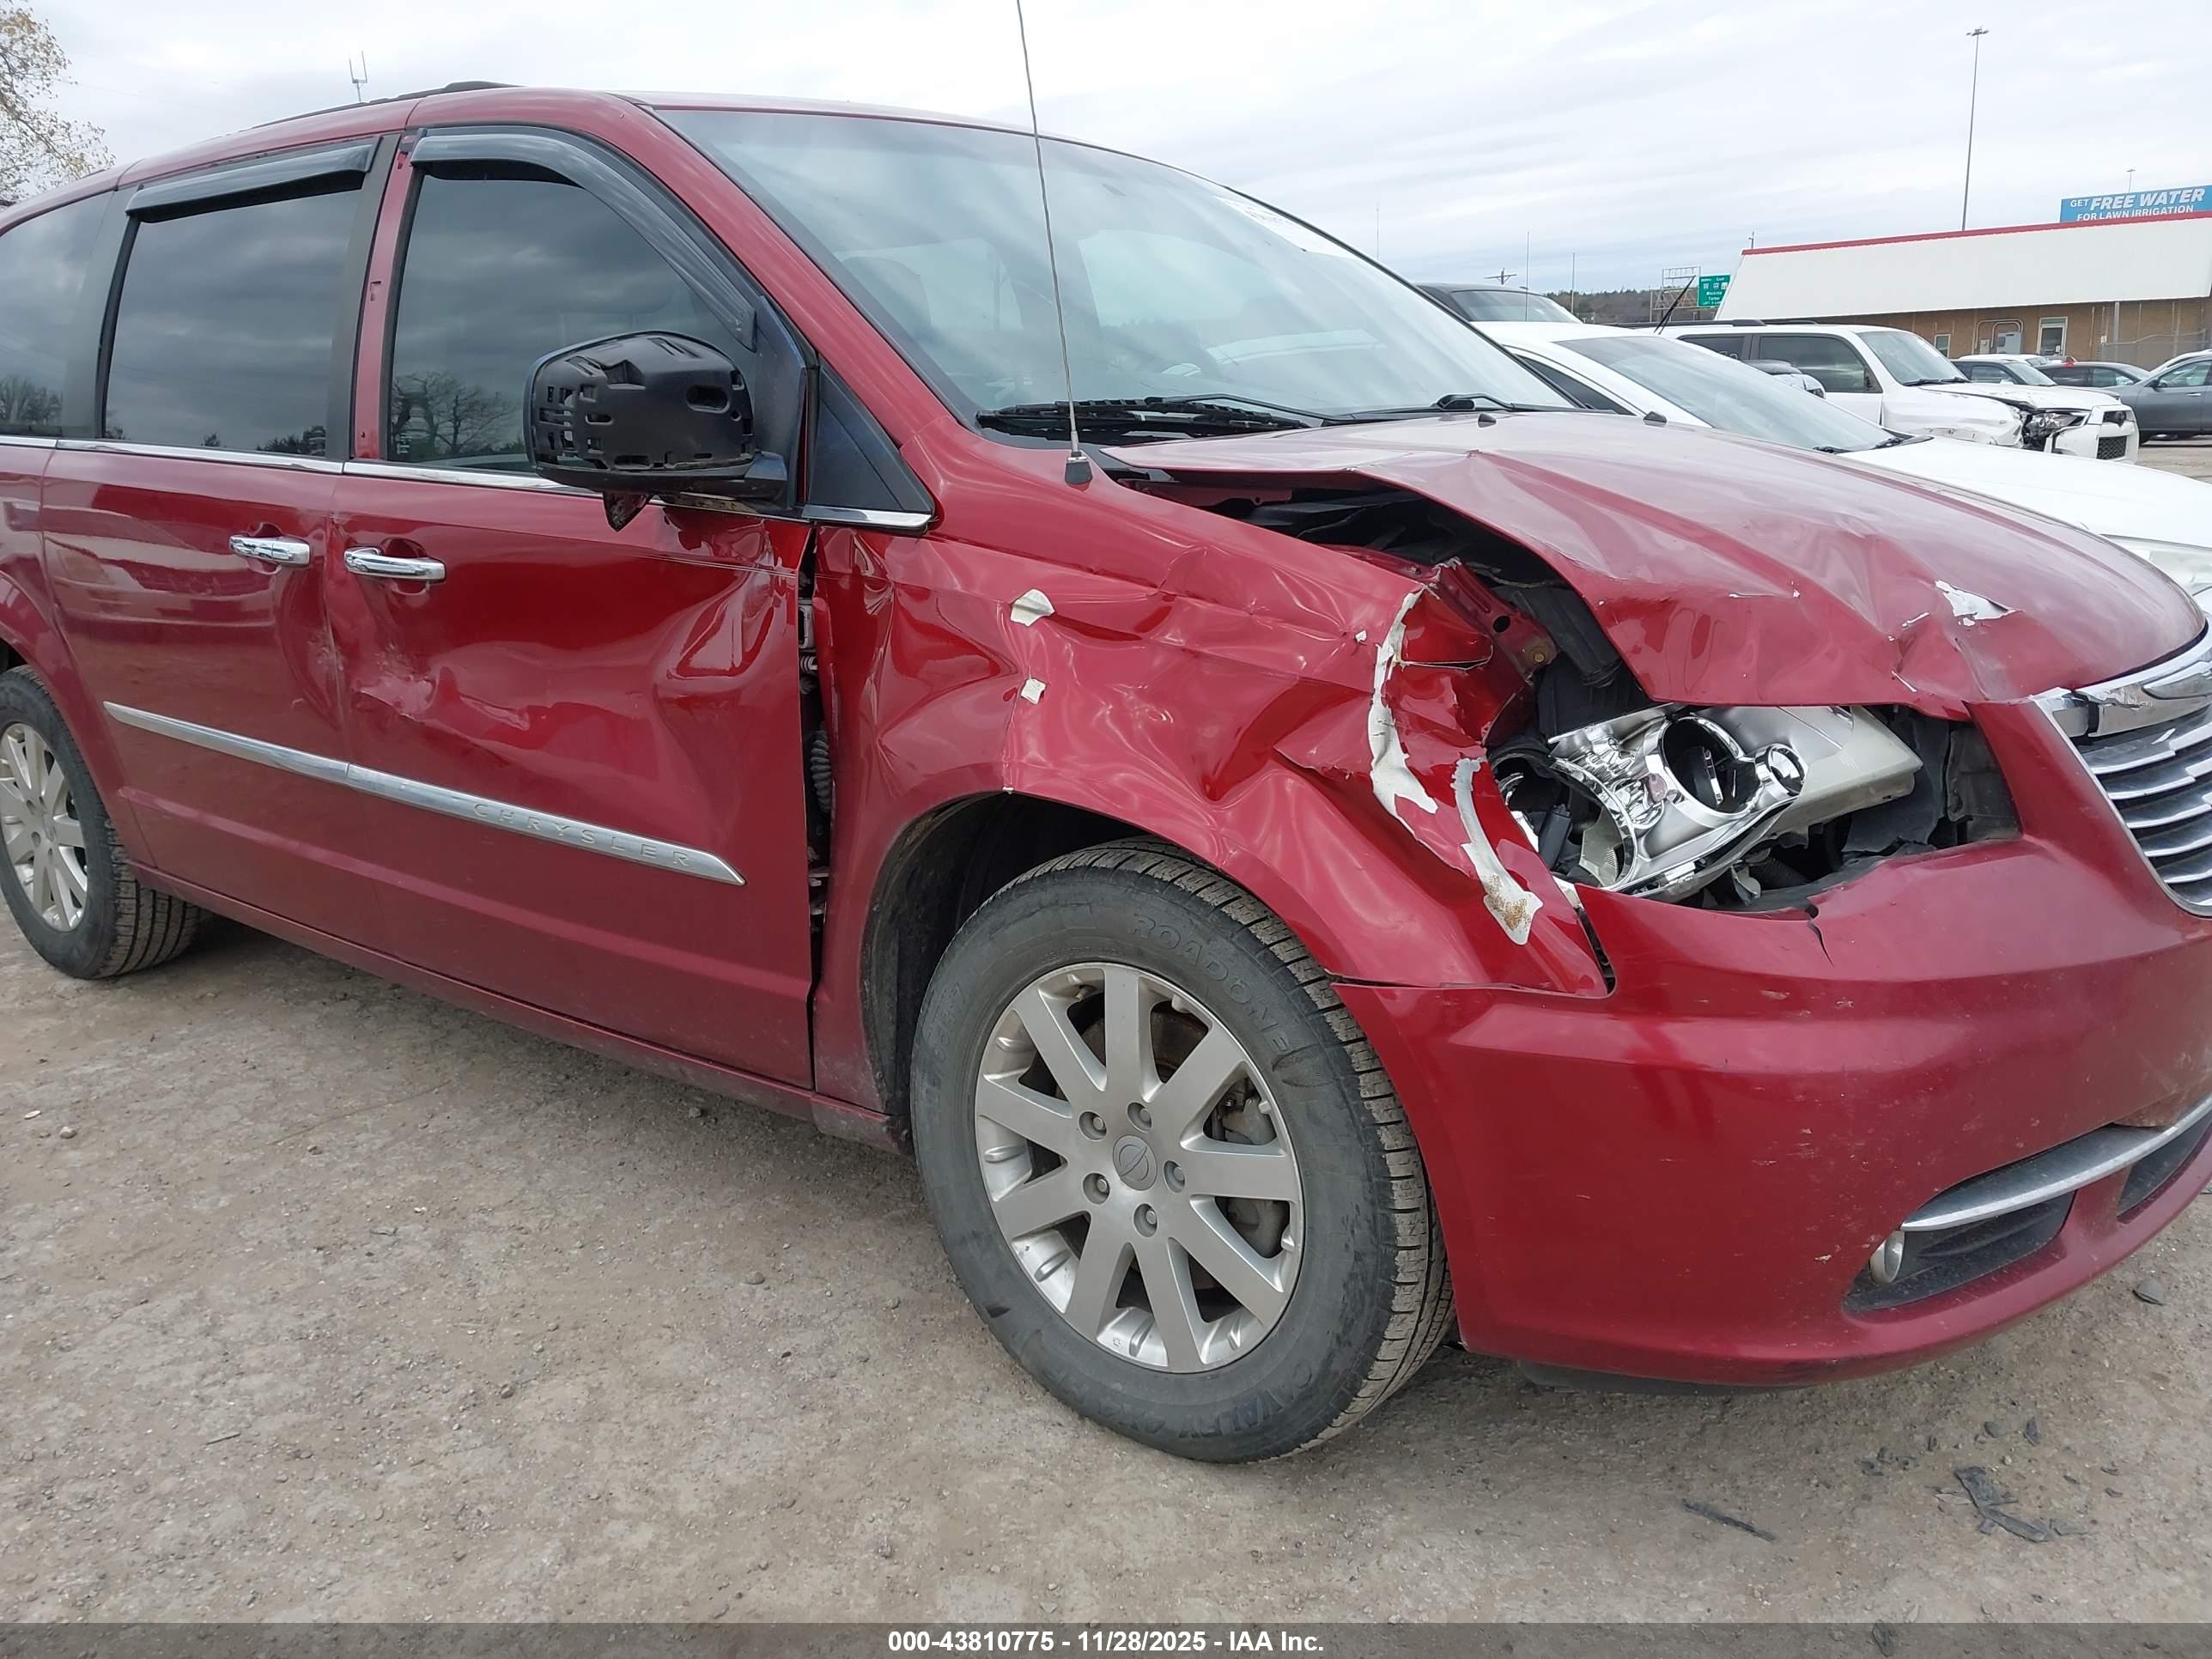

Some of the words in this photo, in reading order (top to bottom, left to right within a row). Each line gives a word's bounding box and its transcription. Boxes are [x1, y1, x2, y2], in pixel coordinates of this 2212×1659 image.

[2070, 198, 2089, 207] GET
[2090, 195, 2136, 210] FREE
[2140, 188, 2206, 207] WATER
[2077, 212, 2099, 222] FOR
[2100, 210, 2130, 220] LAWN
[2131, 204, 2194, 218] IRRIGATION
[473, 803, 690, 866] CHRYSLER
[1132, 912, 1293, 1056] ROADONE
